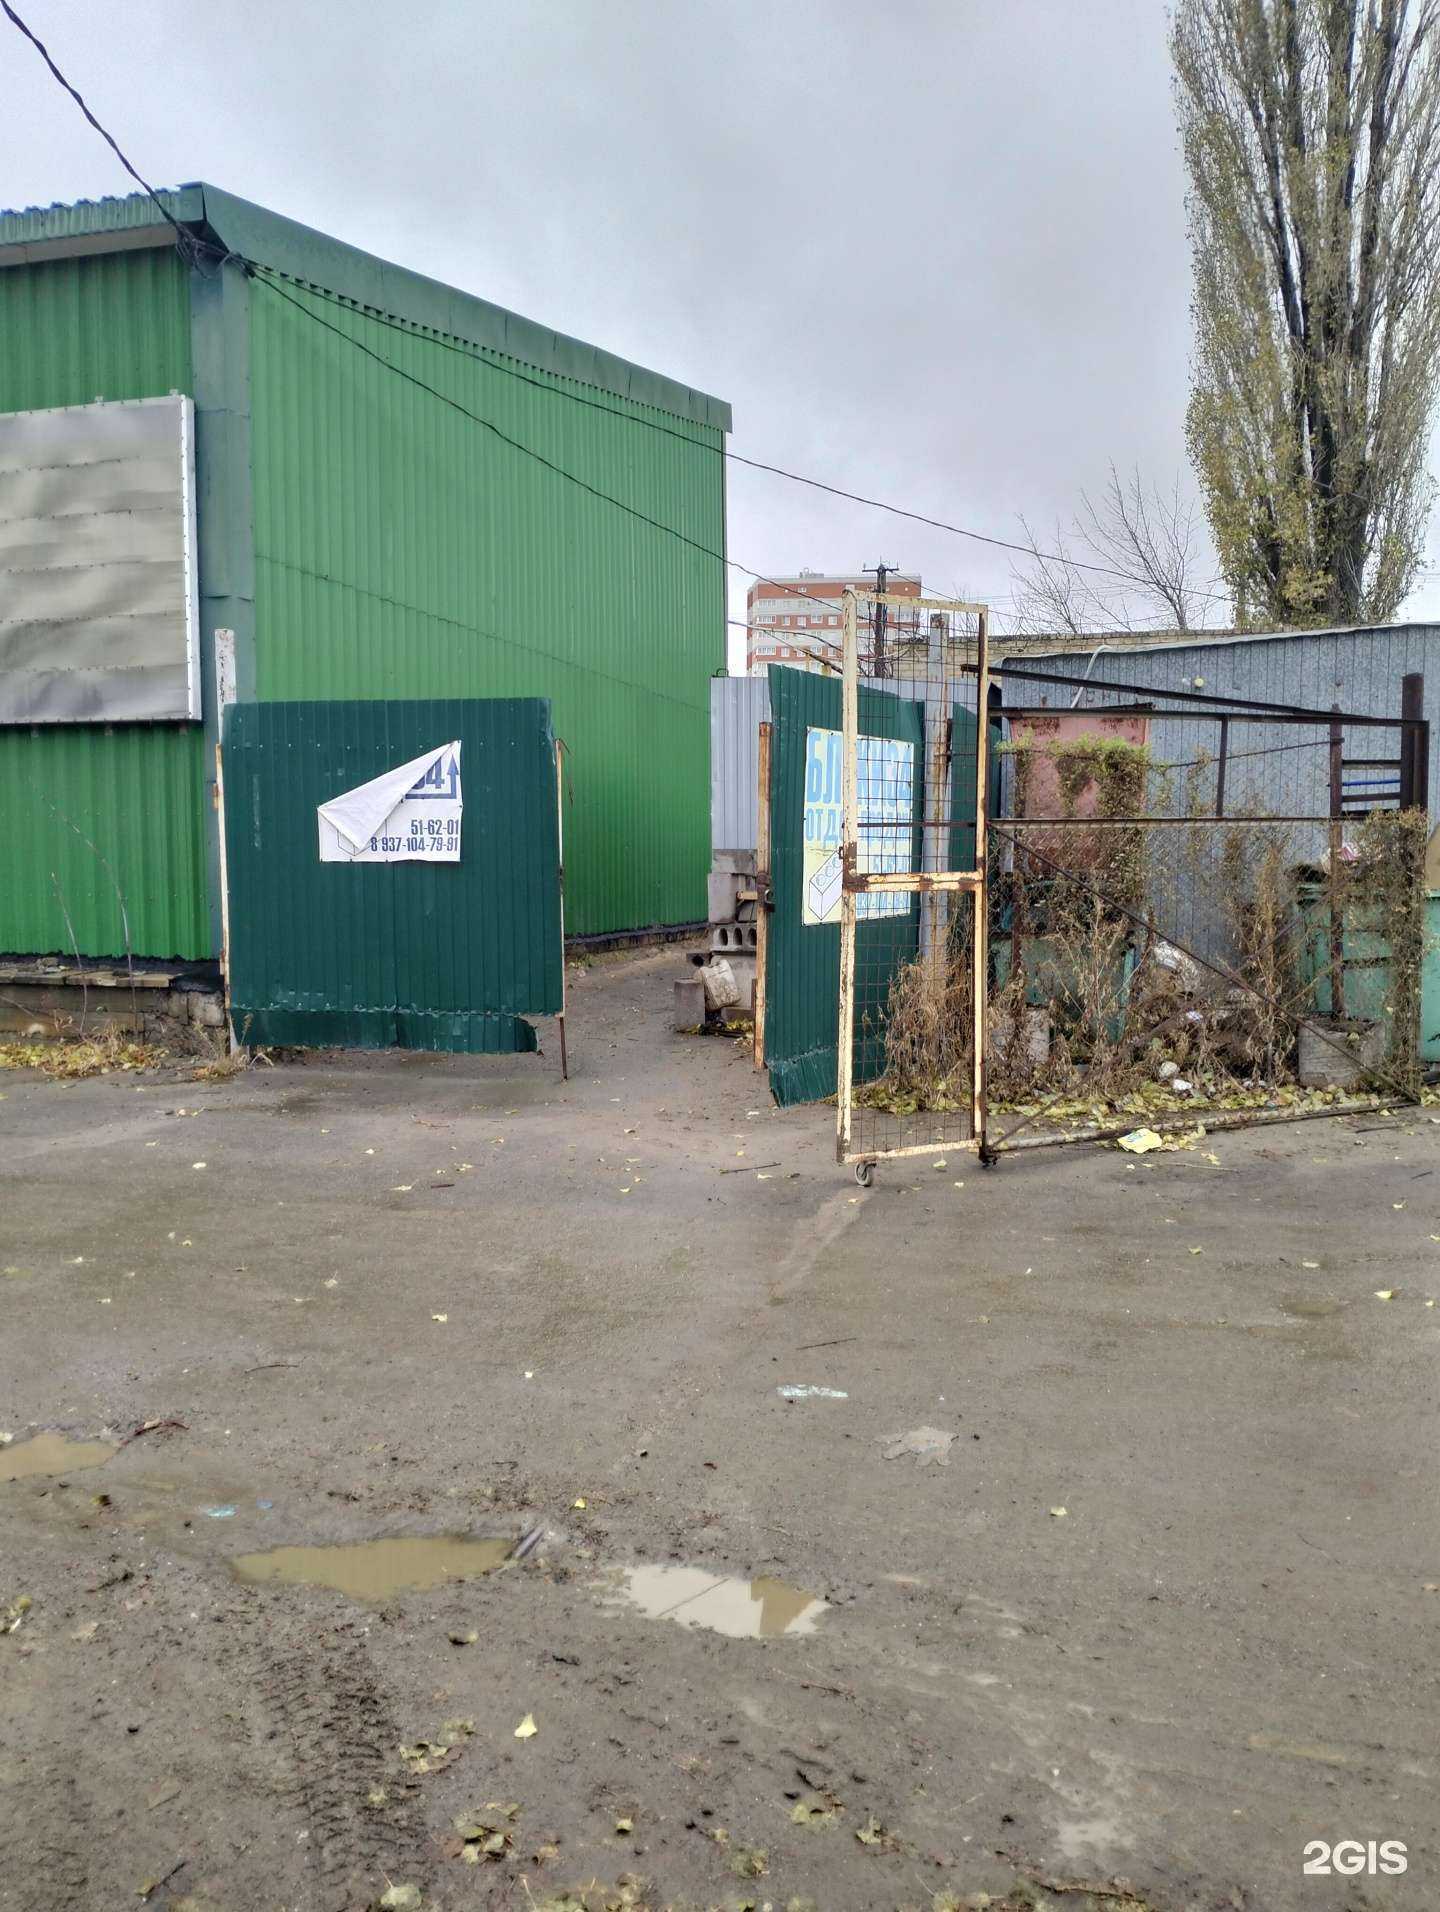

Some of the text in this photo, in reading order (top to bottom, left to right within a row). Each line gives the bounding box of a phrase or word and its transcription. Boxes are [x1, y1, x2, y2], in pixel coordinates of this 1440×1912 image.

[410, 819, 459, 836] 51-62-01
[370, 836, 458, 852] 8 937-104-79-91
